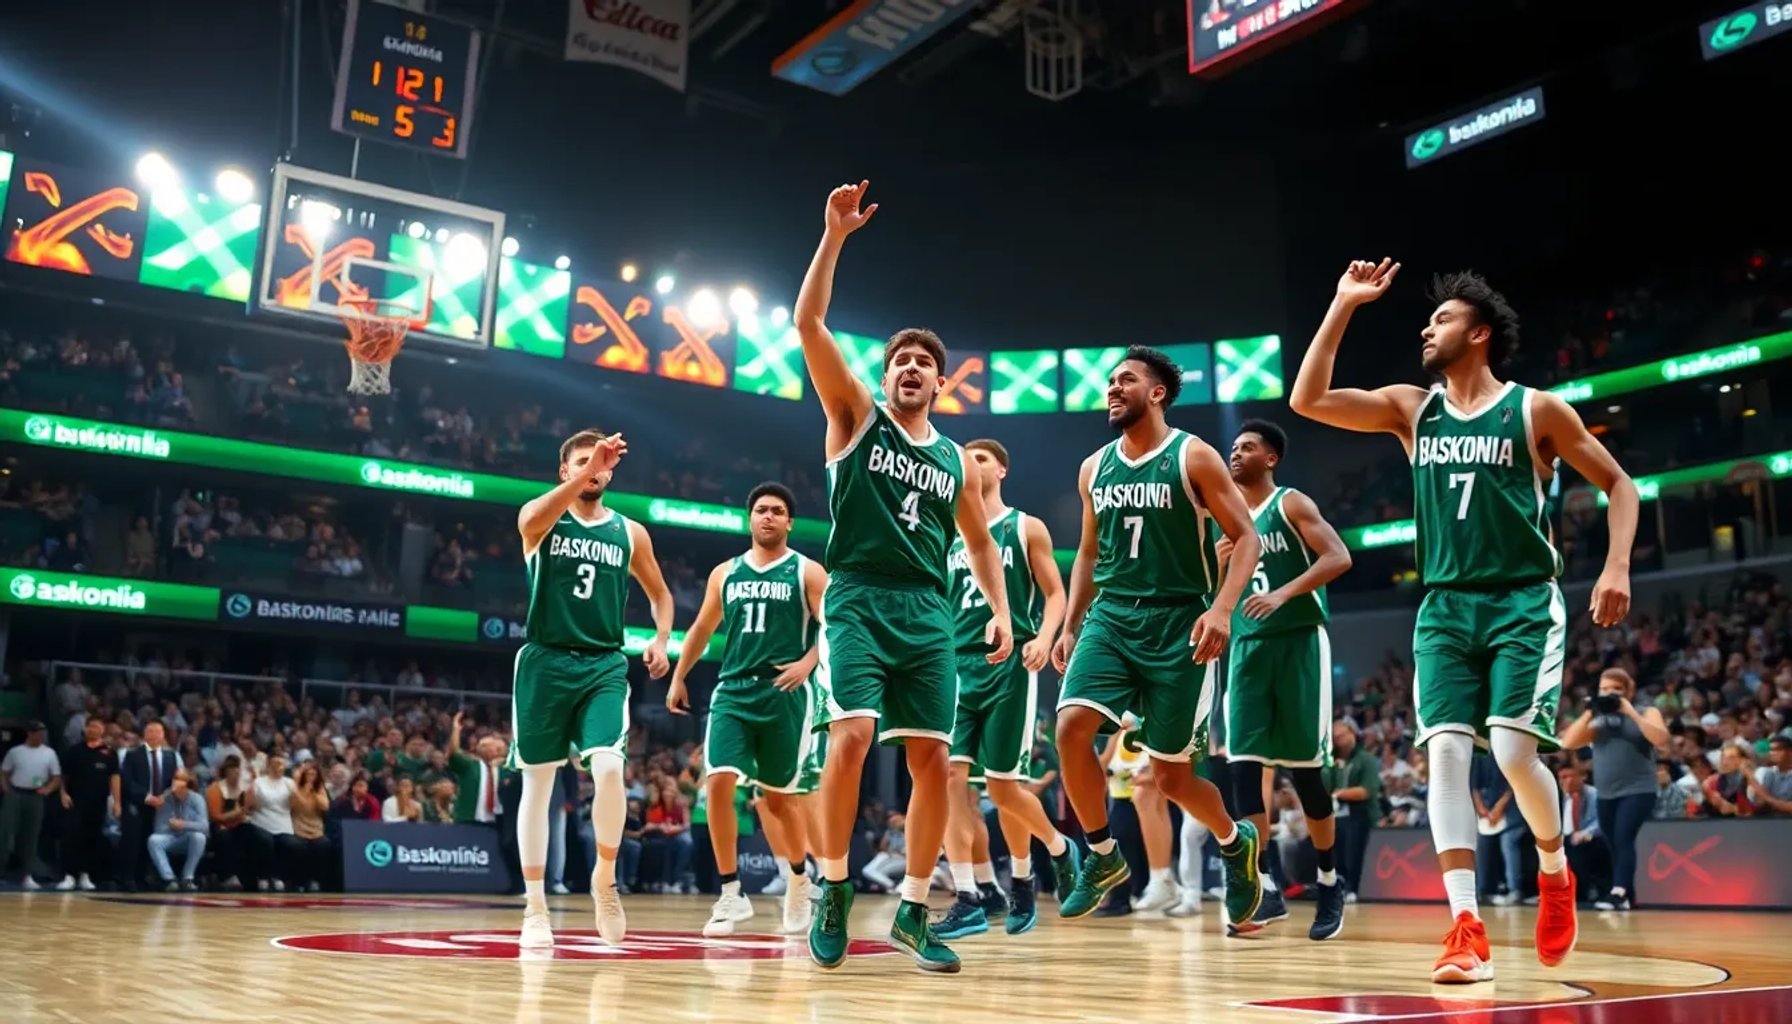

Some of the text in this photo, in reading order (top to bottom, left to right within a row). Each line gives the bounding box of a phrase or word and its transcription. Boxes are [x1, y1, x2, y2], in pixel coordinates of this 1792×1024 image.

[395, 104, 416, 139] 5
[1417, 435, 1514, 468] BASKONIA
[867, 444, 957, 504] BASKONIA
[899, 491, 920, 532] 4
[1449, 471, 1476, 520] 7
[1123, 515, 1144, 560] 7
[572, 563, 597, 600] 3
[741, 602, 767, 634] 11
